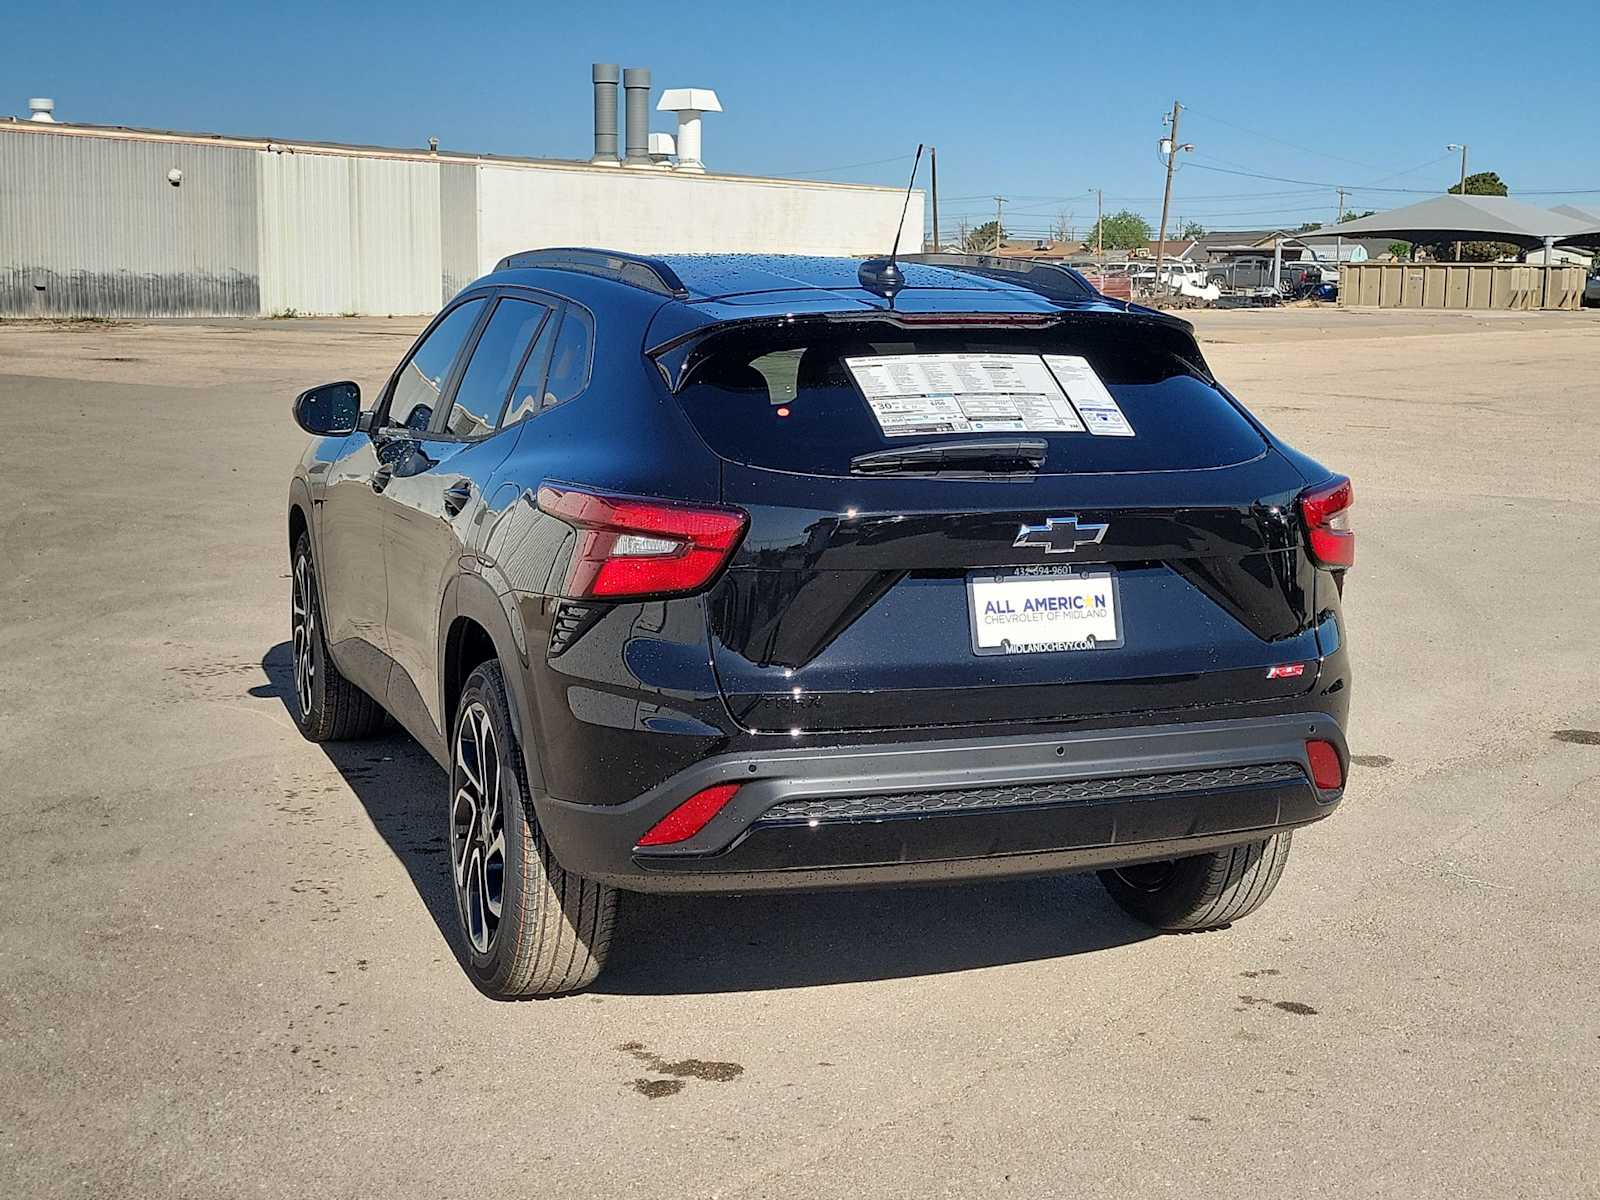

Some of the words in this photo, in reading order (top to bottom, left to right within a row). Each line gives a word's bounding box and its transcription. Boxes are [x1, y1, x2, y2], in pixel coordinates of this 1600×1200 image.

[984, 600, 1015, 615] ALL
[984, 611, 1045, 625] CHEVROLET
[1046, 611, 1059, 621] OF
[1063, 608, 1107, 621] MIDLAND
[1005, 639, 1096, 655] MIDLANDCHEVY.COM
